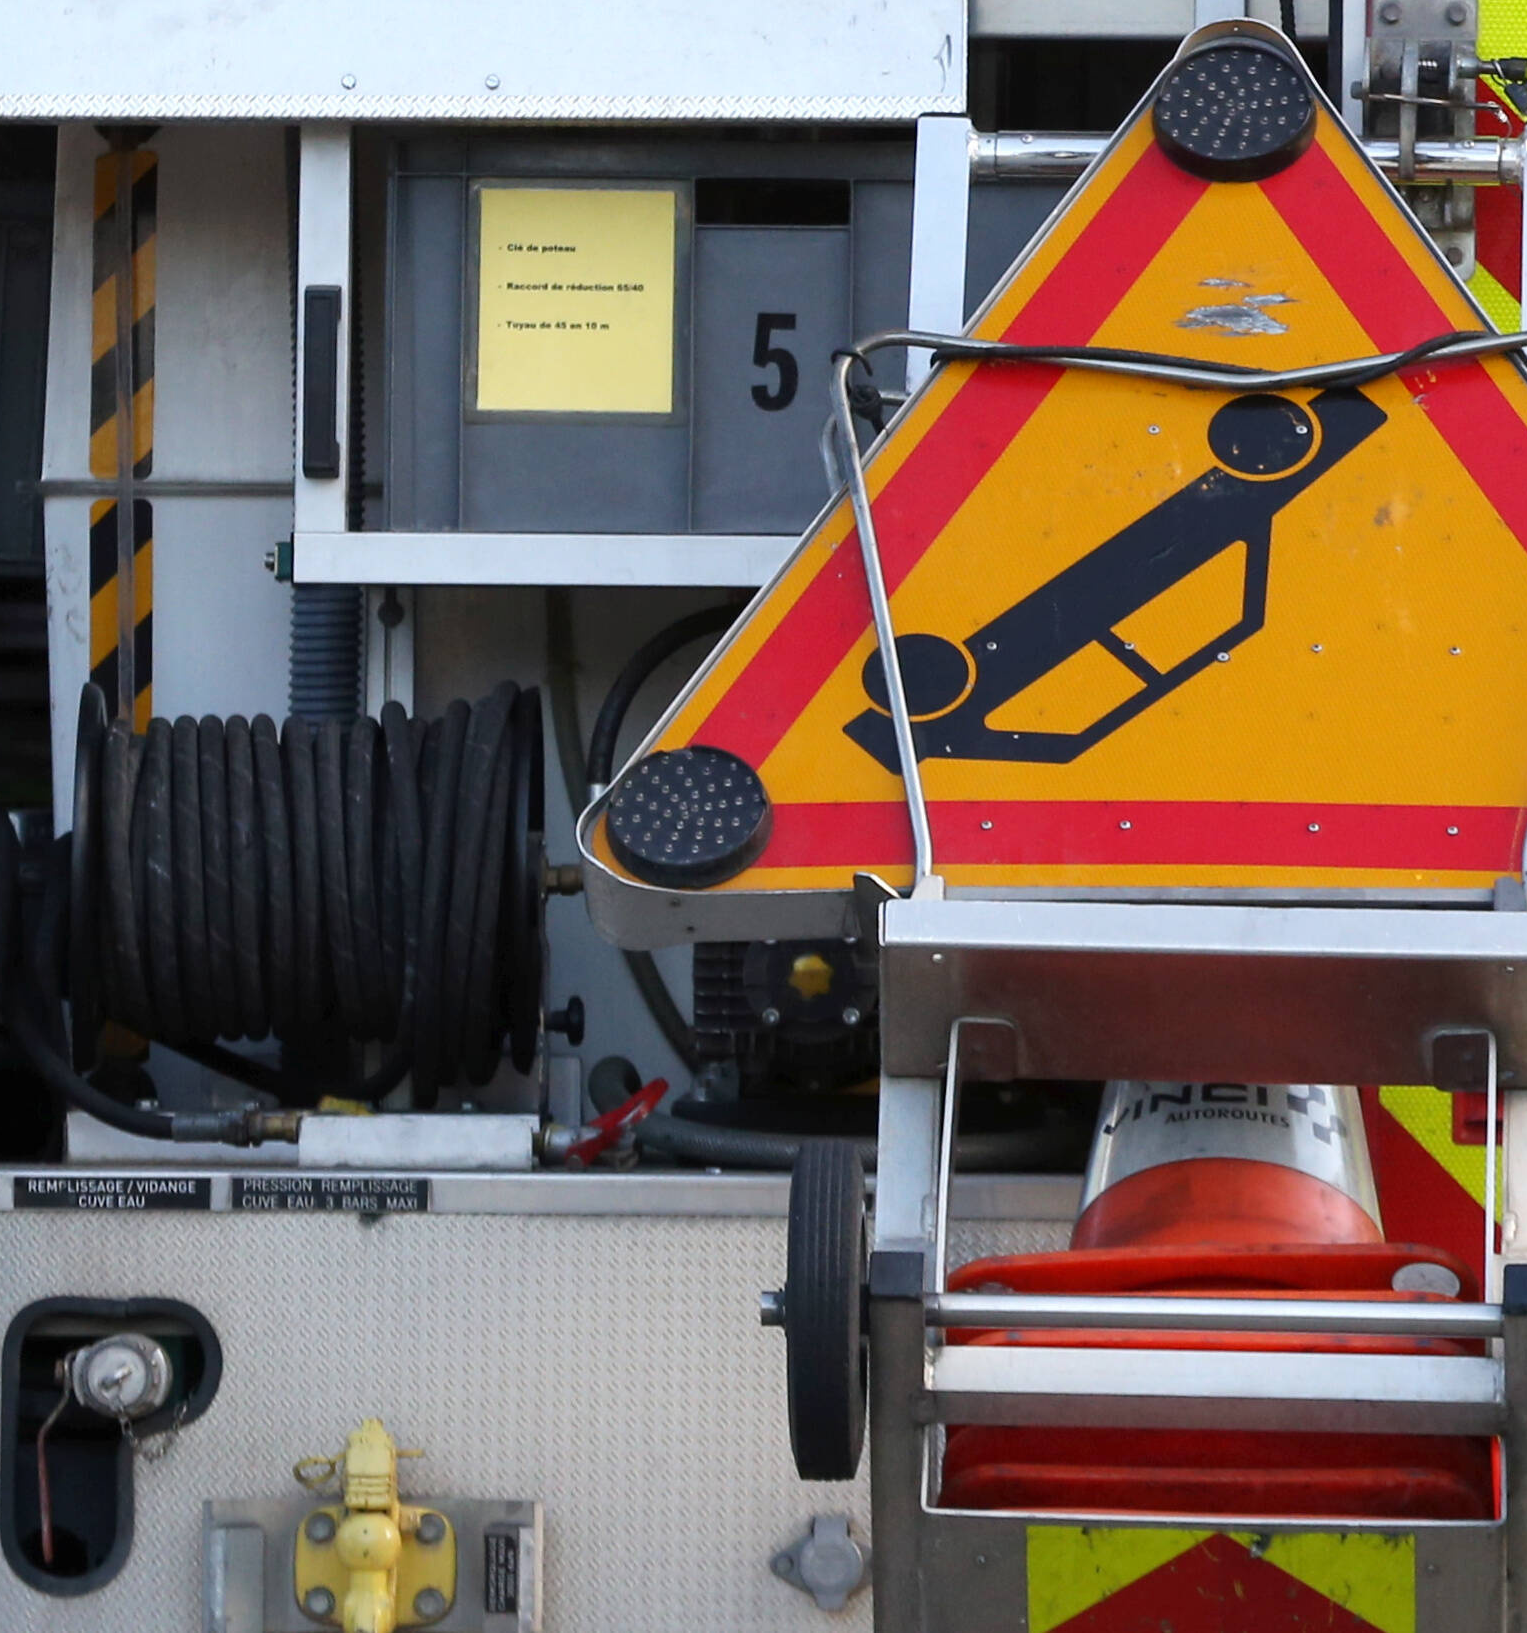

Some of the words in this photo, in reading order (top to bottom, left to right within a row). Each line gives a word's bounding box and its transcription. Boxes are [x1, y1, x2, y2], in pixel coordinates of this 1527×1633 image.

[526, 244, 539, 253] de
[541, 244, 576, 254] poteau
[506, 282, 548, 291] Raccord
[551, 283, 563, 292] de
[566, 282, 614, 293] réduction
[506, 320, 537, 331] Tuyau
[539, 321, 551, 330] de
[569, 322, 582, 330] en
[750, 312, 799, 412] 5
[1103, 1082, 1268, 1135] VINCI
[1165, 1108, 1290, 1129] AUTOROUTES
[28, 1179, 124, 1194] REMPLISSAGE
[136, 1180, 197, 1194] VIDANGE
[243, 1179, 313, 1192] PRESSION
[321, 1180, 417, 1194] REMPLISSAGE
[78, 1195, 115, 1208] CUVE
[118, 1195, 146, 1208] EAU
[242, 1195, 277, 1208] CUVE
[287, 1195, 314, 1208] EAU
[325, 1196, 334, 1209] 3
[342, 1196, 378, 1210] BARS
[386, 1196, 418, 1210] MAXI
